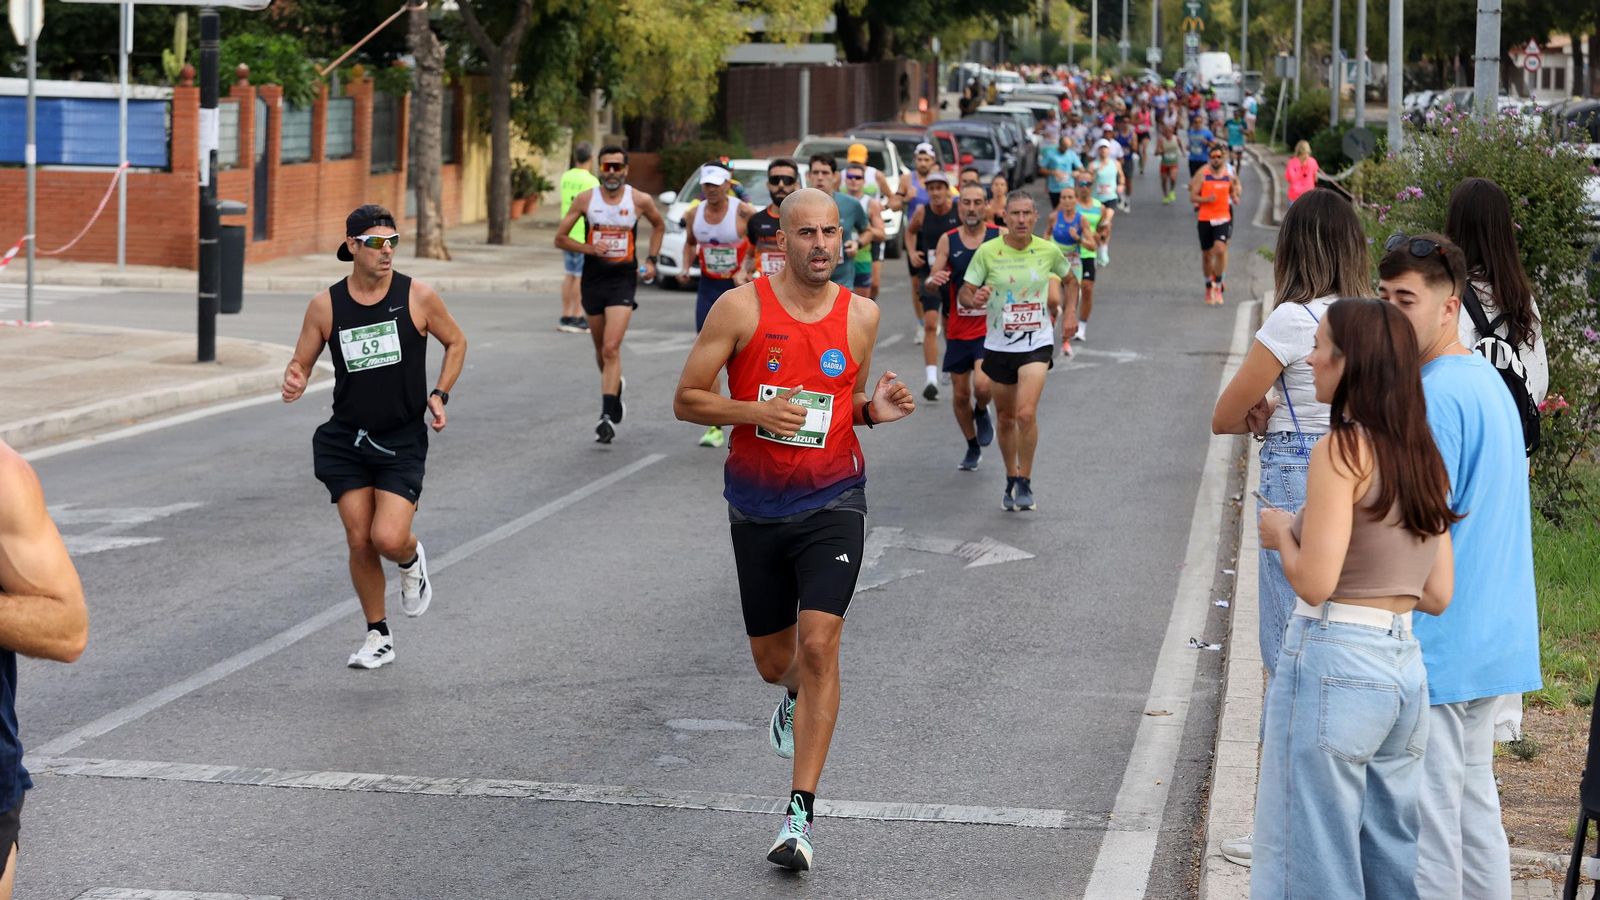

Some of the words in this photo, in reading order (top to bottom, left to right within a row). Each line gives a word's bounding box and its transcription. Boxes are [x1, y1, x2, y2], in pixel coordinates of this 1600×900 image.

[1013, 312, 1033, 322] 267
[362, 340, 379, 355] 69
[823, 361, 843, 370] GADIRA
